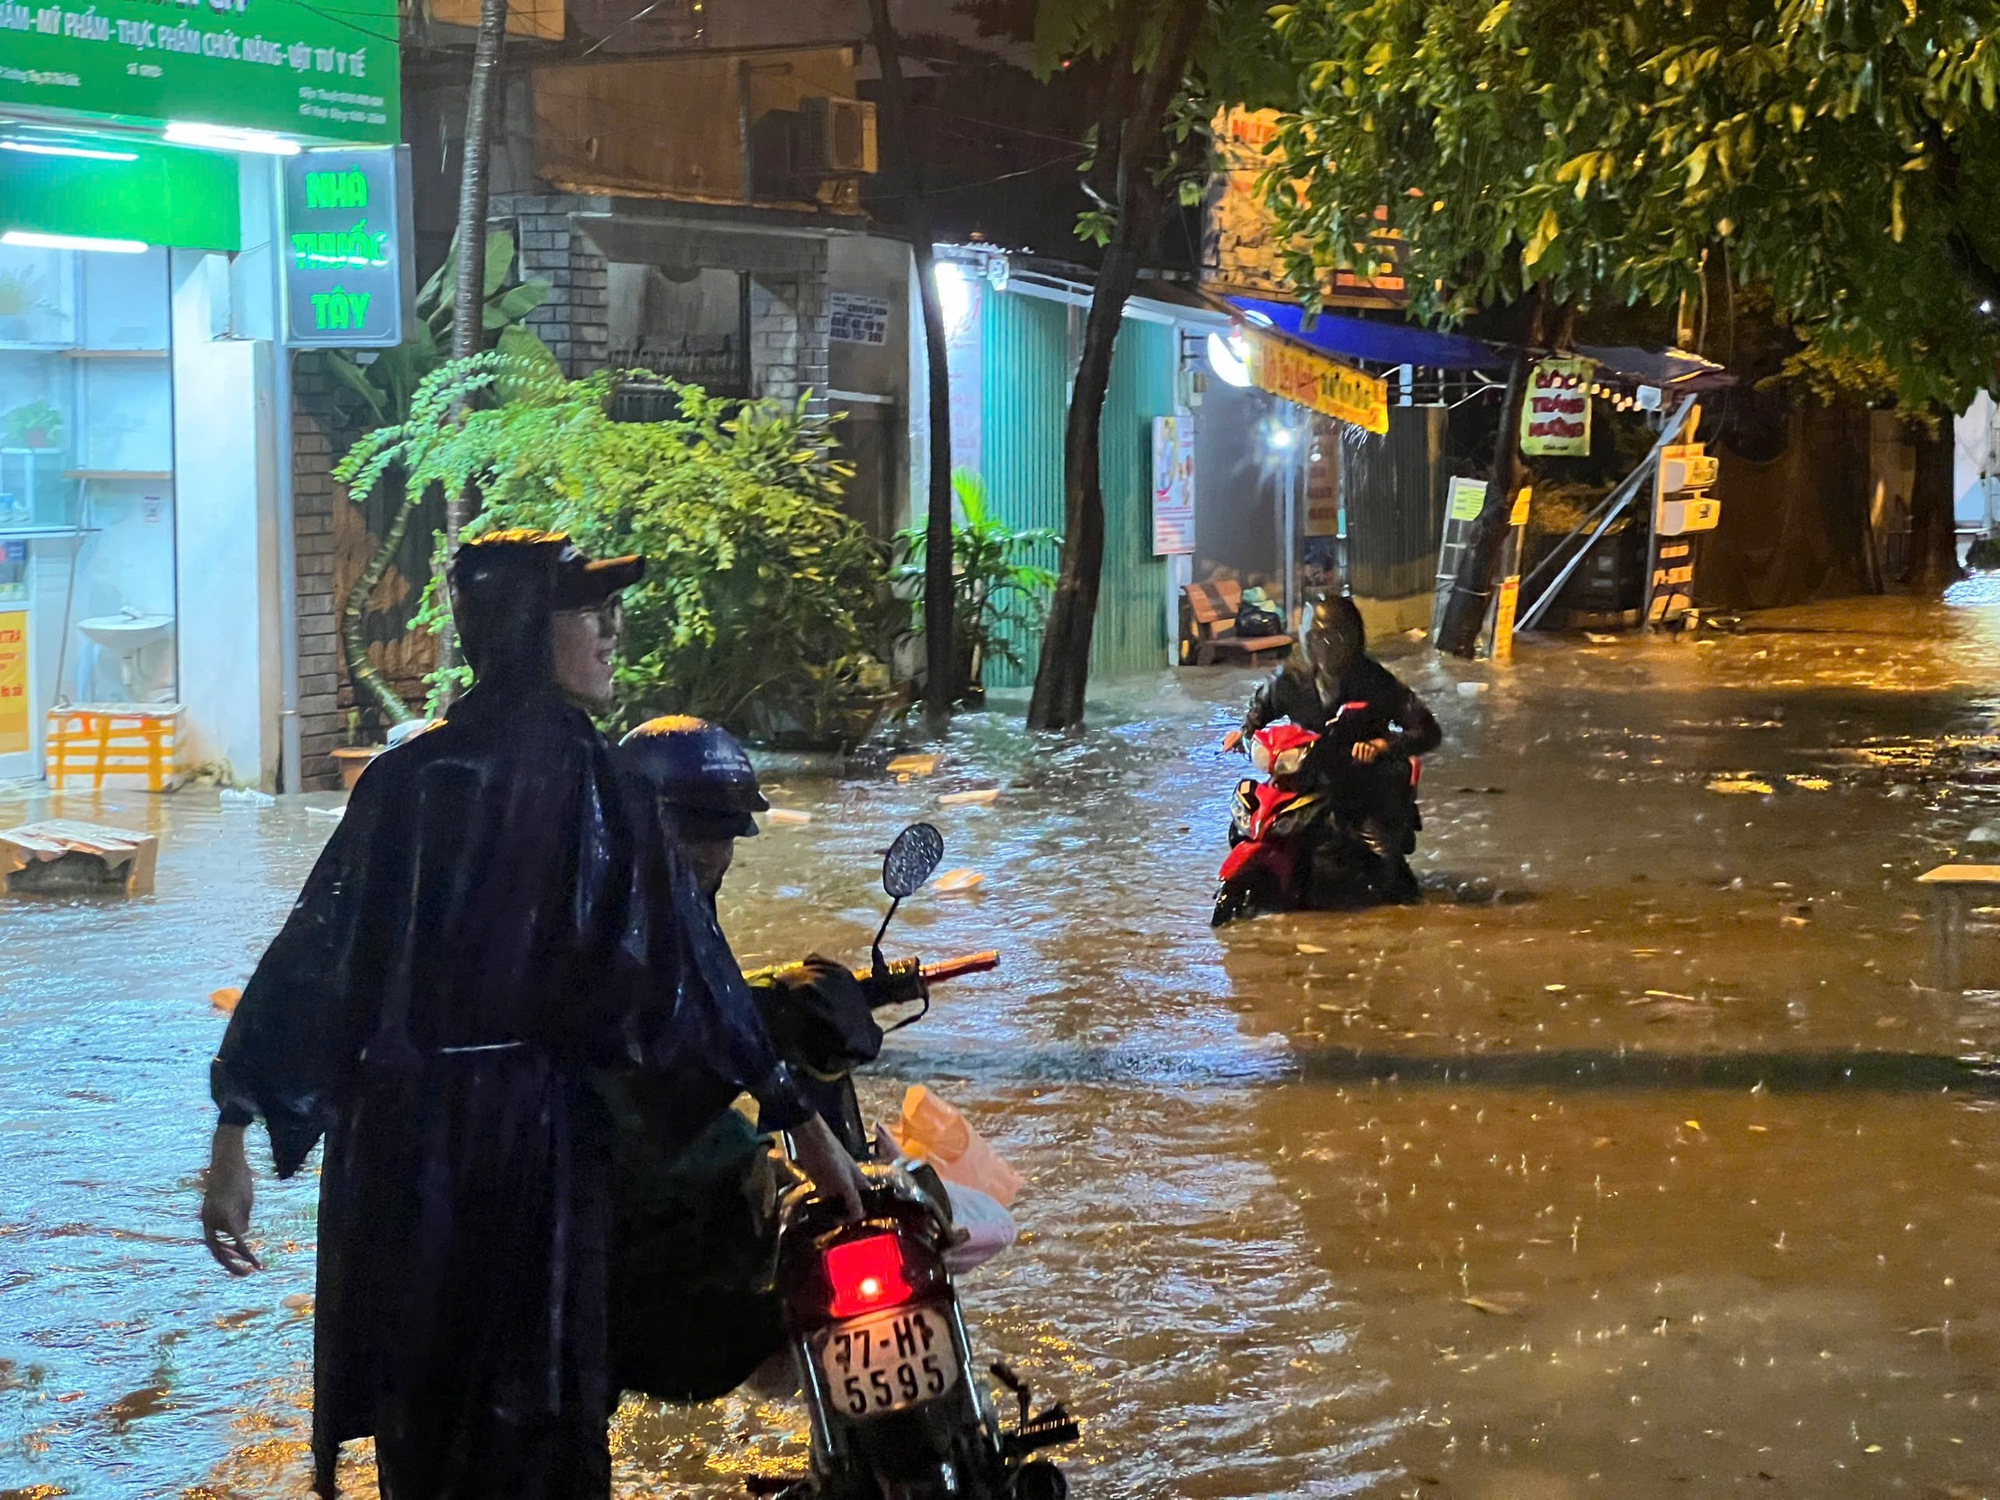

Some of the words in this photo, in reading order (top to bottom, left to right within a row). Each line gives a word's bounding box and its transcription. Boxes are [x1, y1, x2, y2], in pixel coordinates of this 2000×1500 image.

[336, 52, 347, 74] Y
[348, 47, 367, 77] TẾ
[291, 218, 388, 270] THUỐC
[310, 285, 370, 330] TÂY
[844, 1354, 944, 1414] 5595
